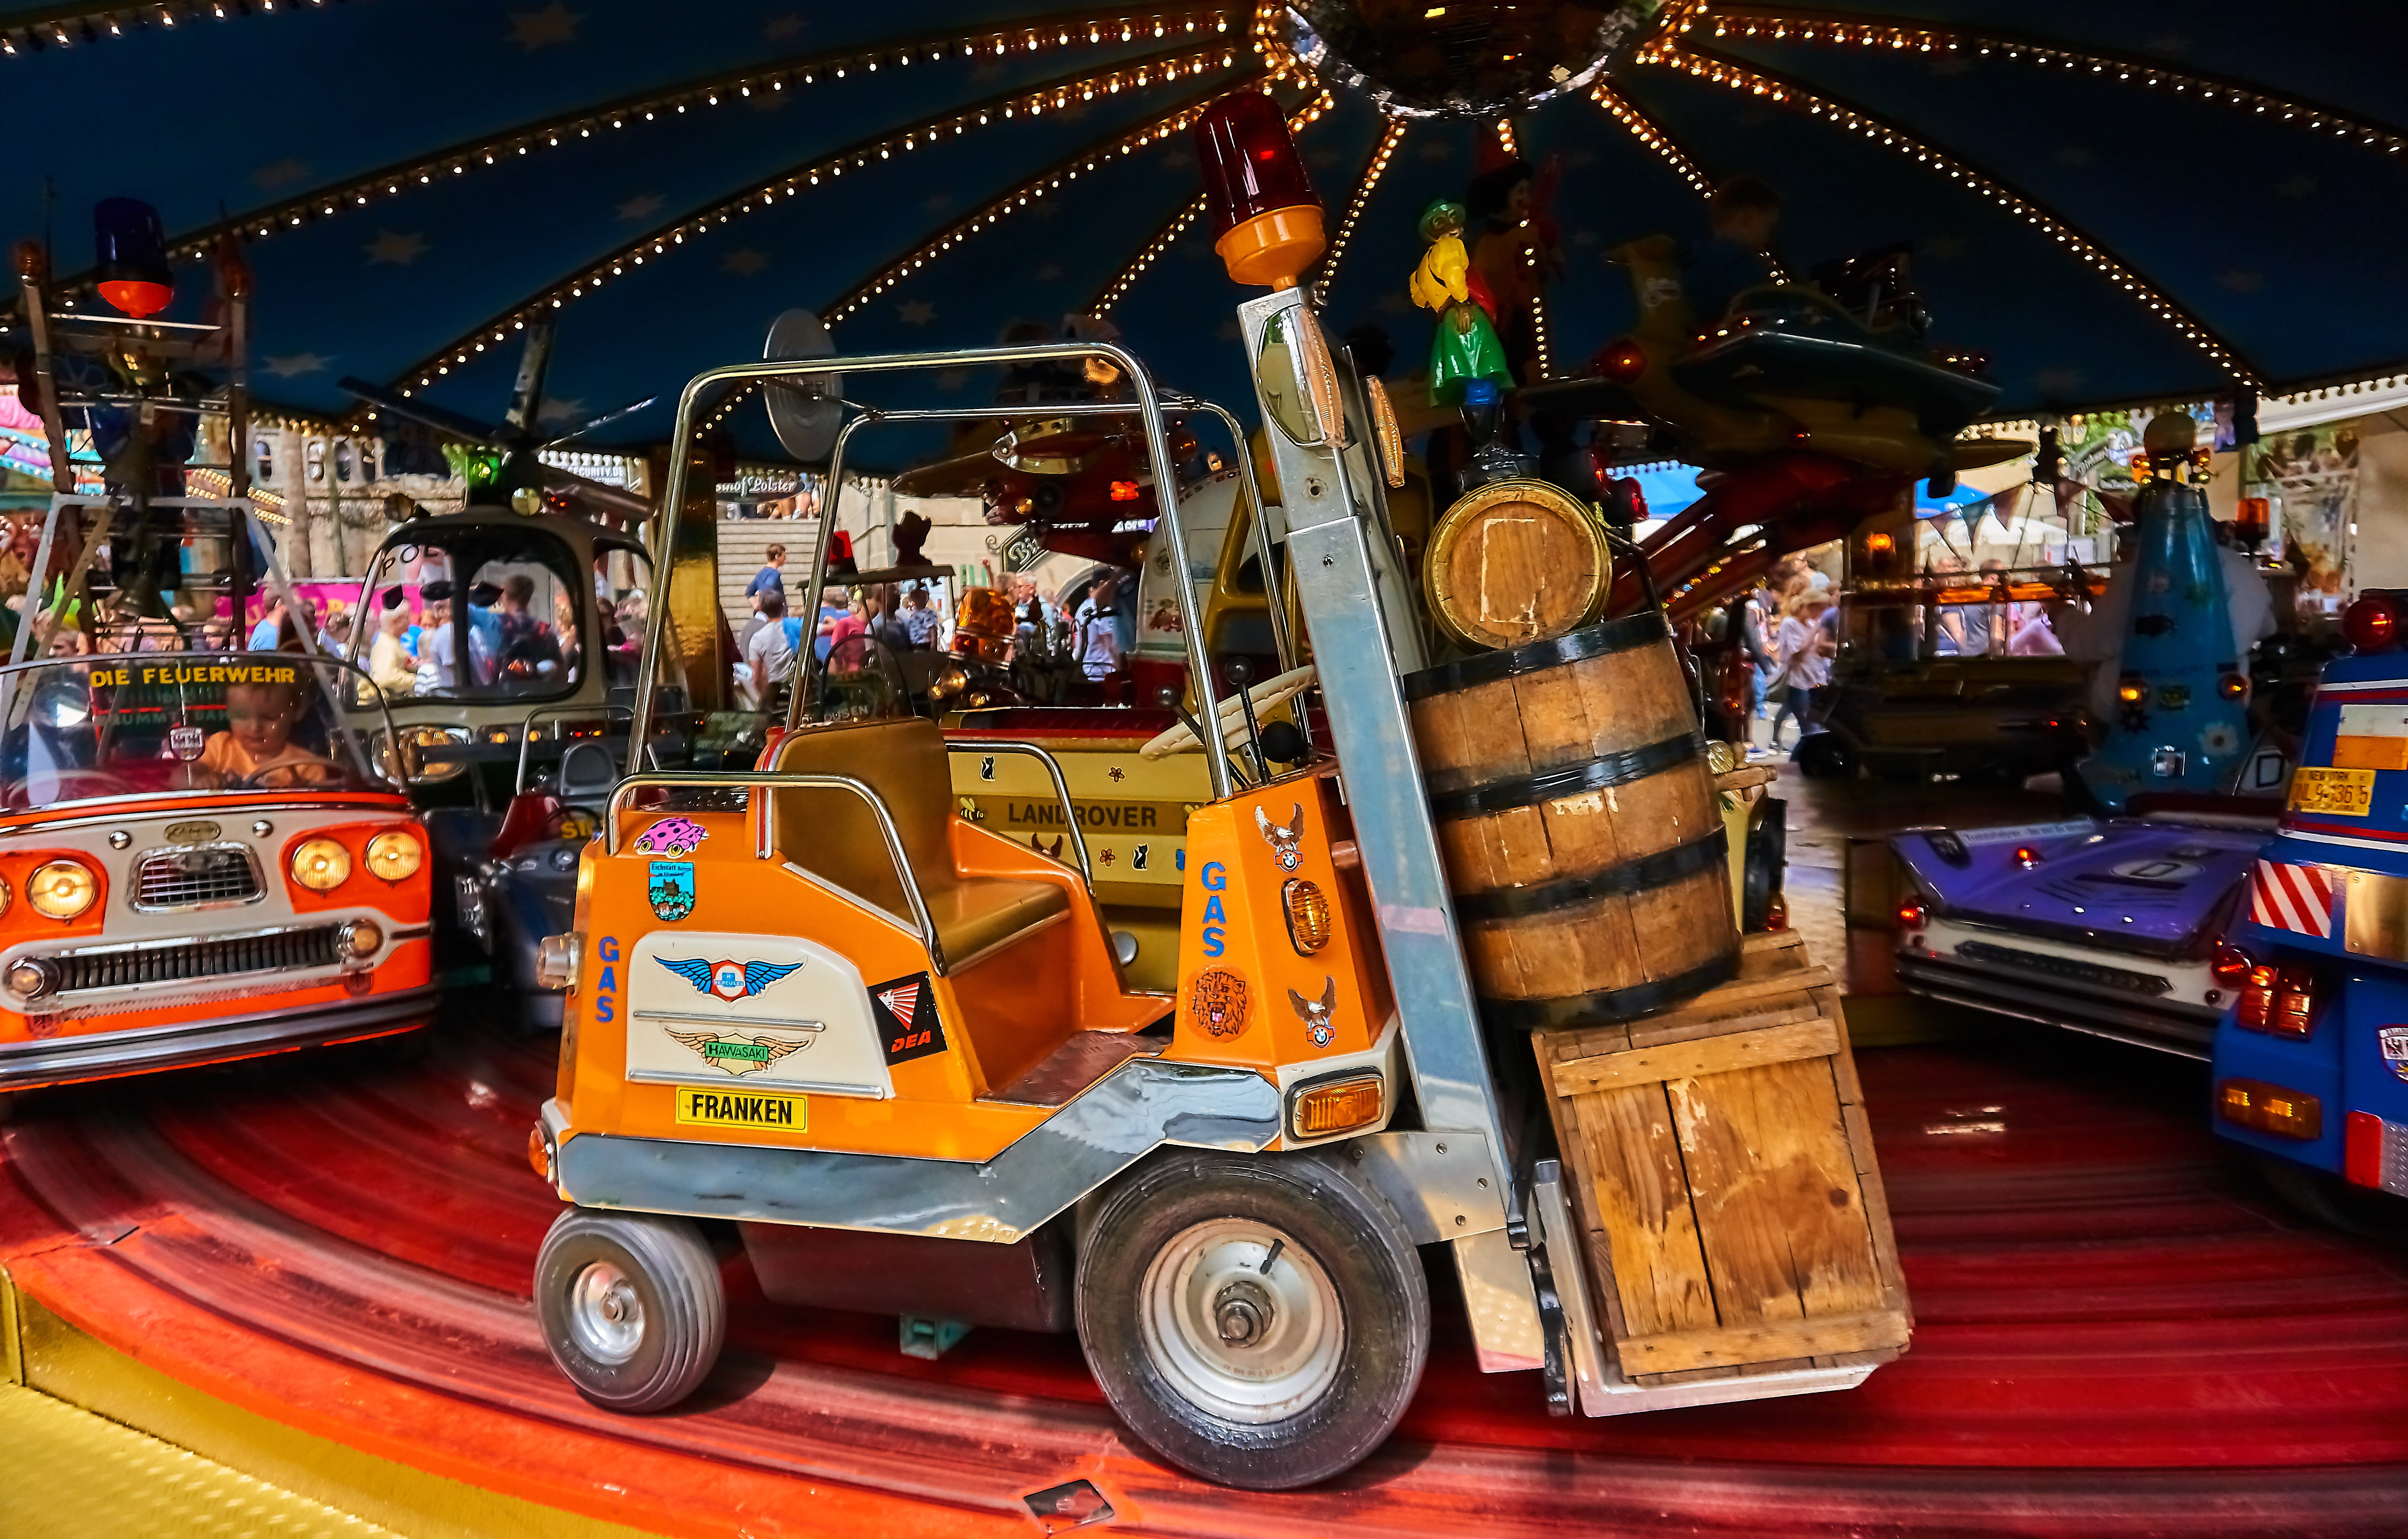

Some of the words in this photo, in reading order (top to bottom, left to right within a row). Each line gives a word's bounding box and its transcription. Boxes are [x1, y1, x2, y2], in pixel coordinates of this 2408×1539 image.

[90, 669, 130, 688] DIE
[143, 667, 295, 684] FEUERWEHR
[1202, 861, 1226, 957] GAS
[595, 936, 619, 1023] GAS
[891, 1030, 931, 1052] DEA
[691, 1094, 792, 1125] FRANKEN
